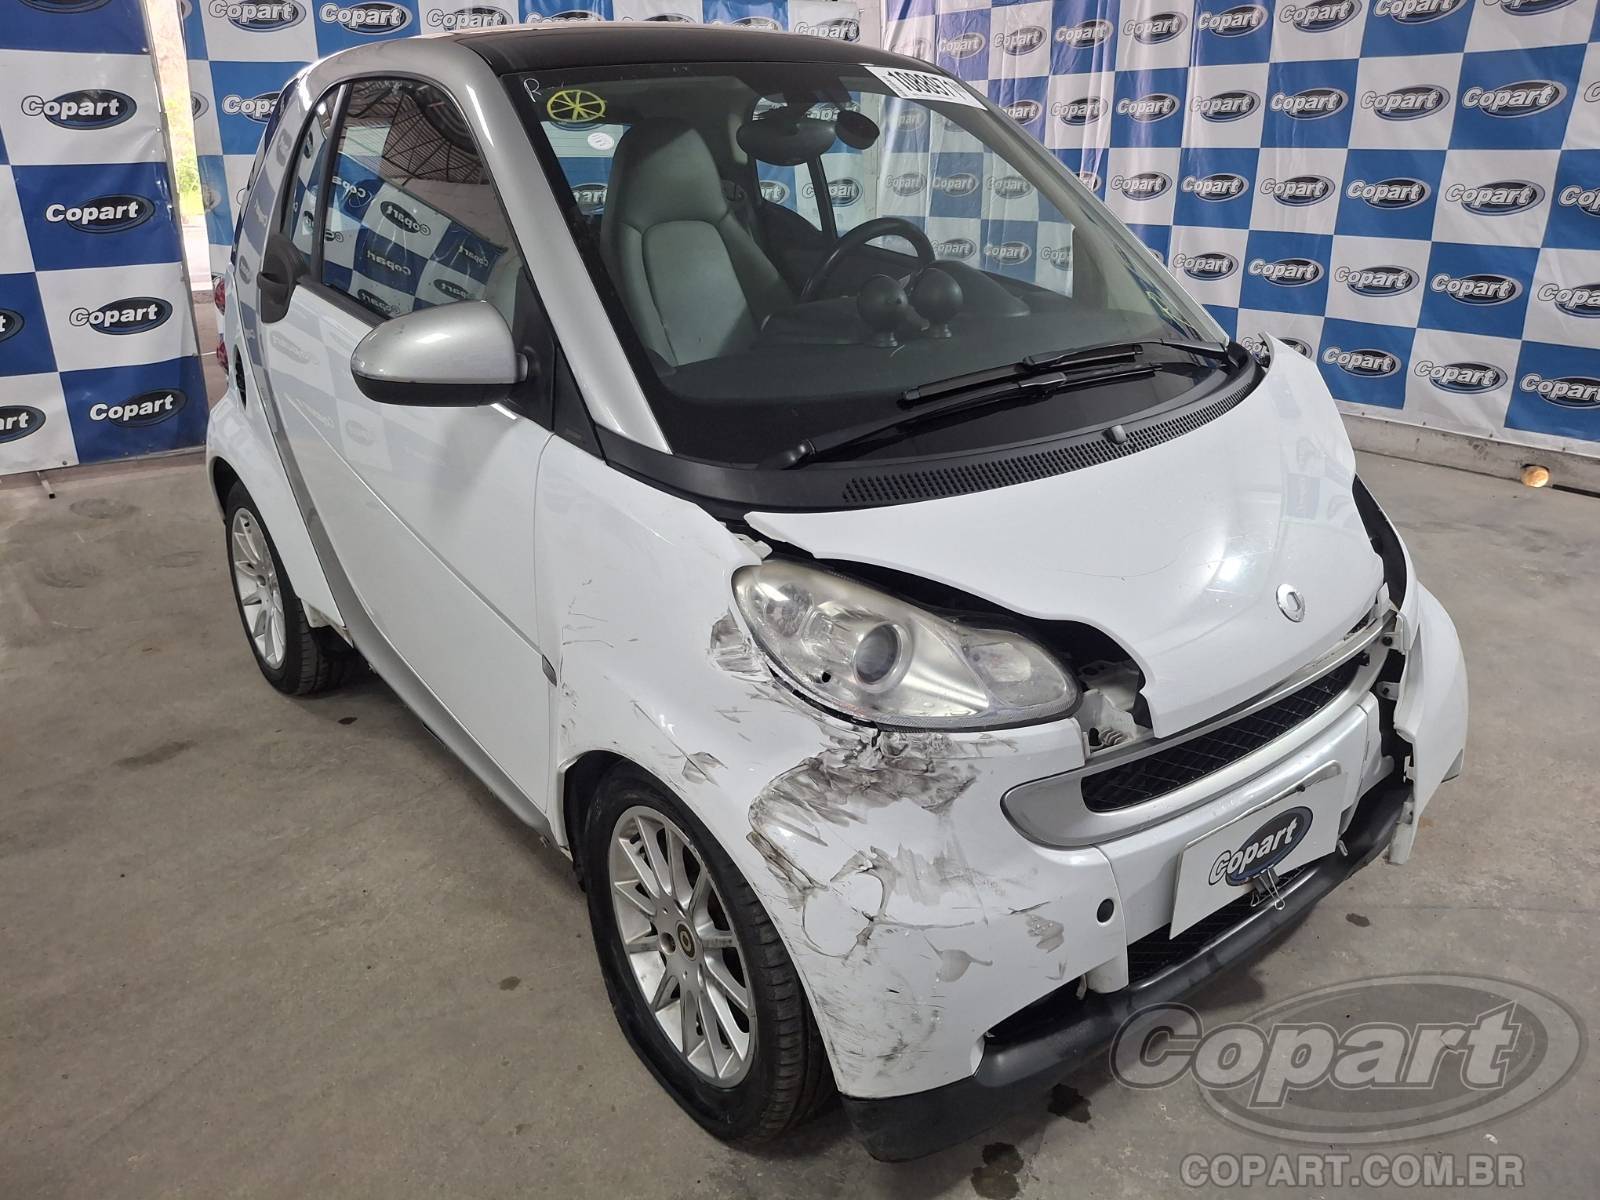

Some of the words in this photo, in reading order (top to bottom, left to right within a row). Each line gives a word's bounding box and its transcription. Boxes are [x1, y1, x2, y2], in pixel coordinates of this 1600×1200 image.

[209, 0, 294, 24] Copart
[319, 3, 402, 28] Copart
[427, 8, 503, 30] Copart
[1198, 10, 1261, 32] Copart
[1280, 3, 1349, 27] Copart
[1374, 0, 1452, 19] Copart
[1055, 22, 1105, 43] Copart
[1123, 17, 1179, 38] Copart
[993, 32, 1040, 48] Copart
[523, 78, 542, 102] R
[1361, 90, 1440, 113] Copart
[1462, 85, 1557, 111] Copart
[21, 95, 121, 119] Copart
[1051, 101, 1104, 120] Copart
[1116, 98, 1171, 116] Copart
[1190, 92, 1250, 114] Copart
[1271, 91, 1342, 115] Copart
[1111, 175, 1162, 192] Copart
[1181, 176, 1239, 196] Copart
[1260, 178, 1325, 197] Copart
[1346, 180, 1422, 204] Copart
[1446, 183, 1534, 208] Copart
[46, 201, 140, 223] Copart
[1173, 253, 1230, 273] Copart
[1248, 259, 1317, 280] Copart
[1334, 266, 1409, 289] Copart
[1430, 273, 1513, 298] Copart
[1538, 283, 1600, 310] Copa
[69, 303, 158, 328] Copart
[1322, 347, 1394, 373] Copart
[1414, 360, 1498, 386] Copart
[89, 395, 175, 422] Copart
[1208, 817, 1299, 886] Copart
